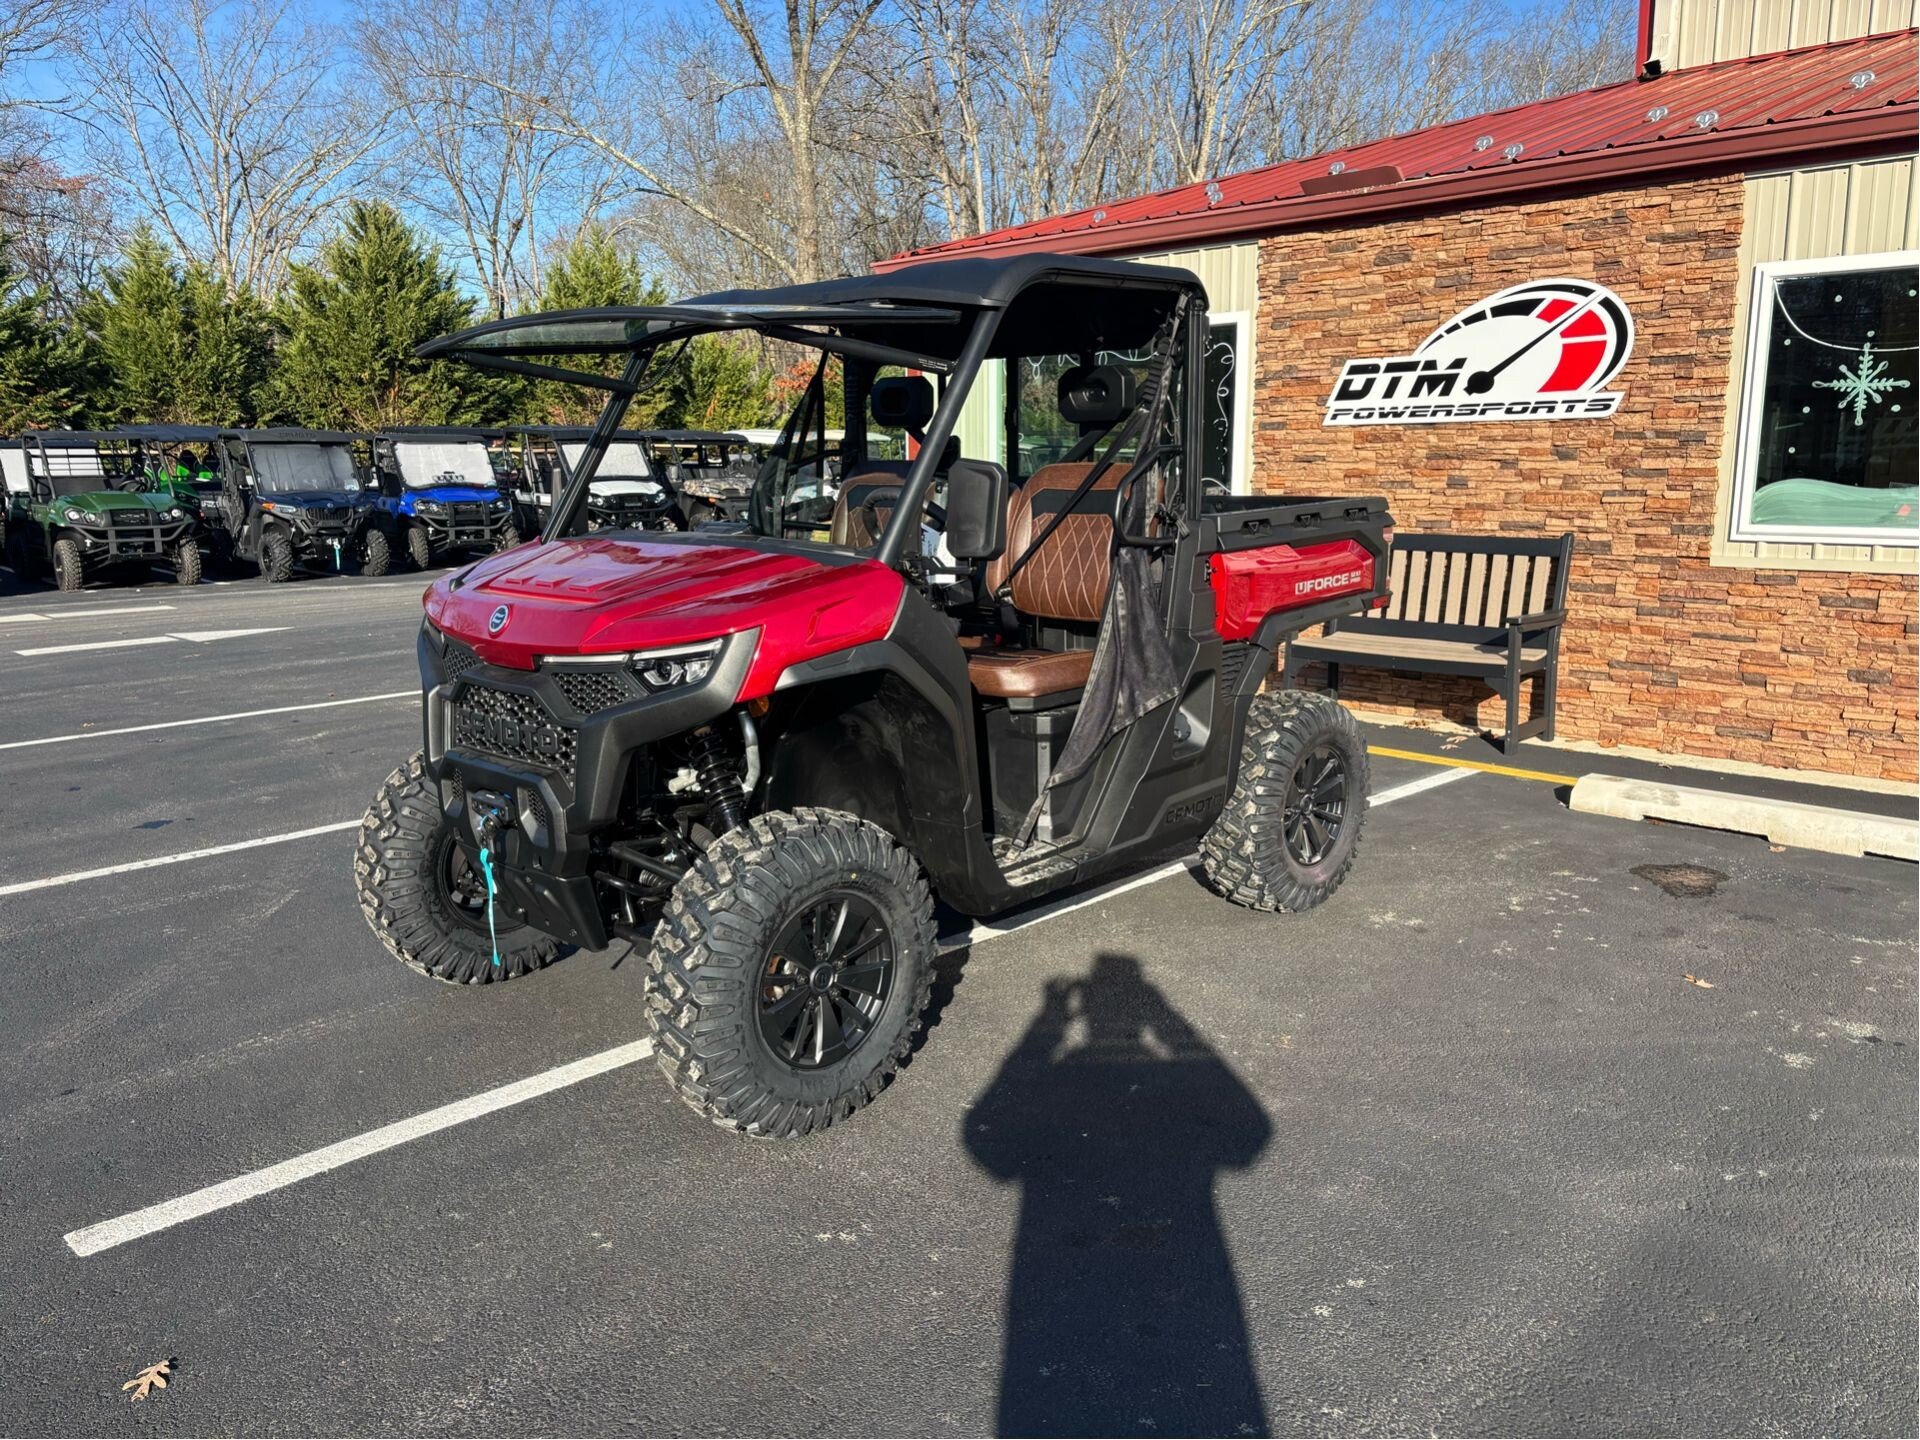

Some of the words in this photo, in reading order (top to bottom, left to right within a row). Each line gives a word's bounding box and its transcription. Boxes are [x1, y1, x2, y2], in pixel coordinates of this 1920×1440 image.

[1334, 357, 1468, 402] DTM
[1330, 397, 1616, 421] POWERSPORTS
[1295, 572, 1349, 595] UFORCE
